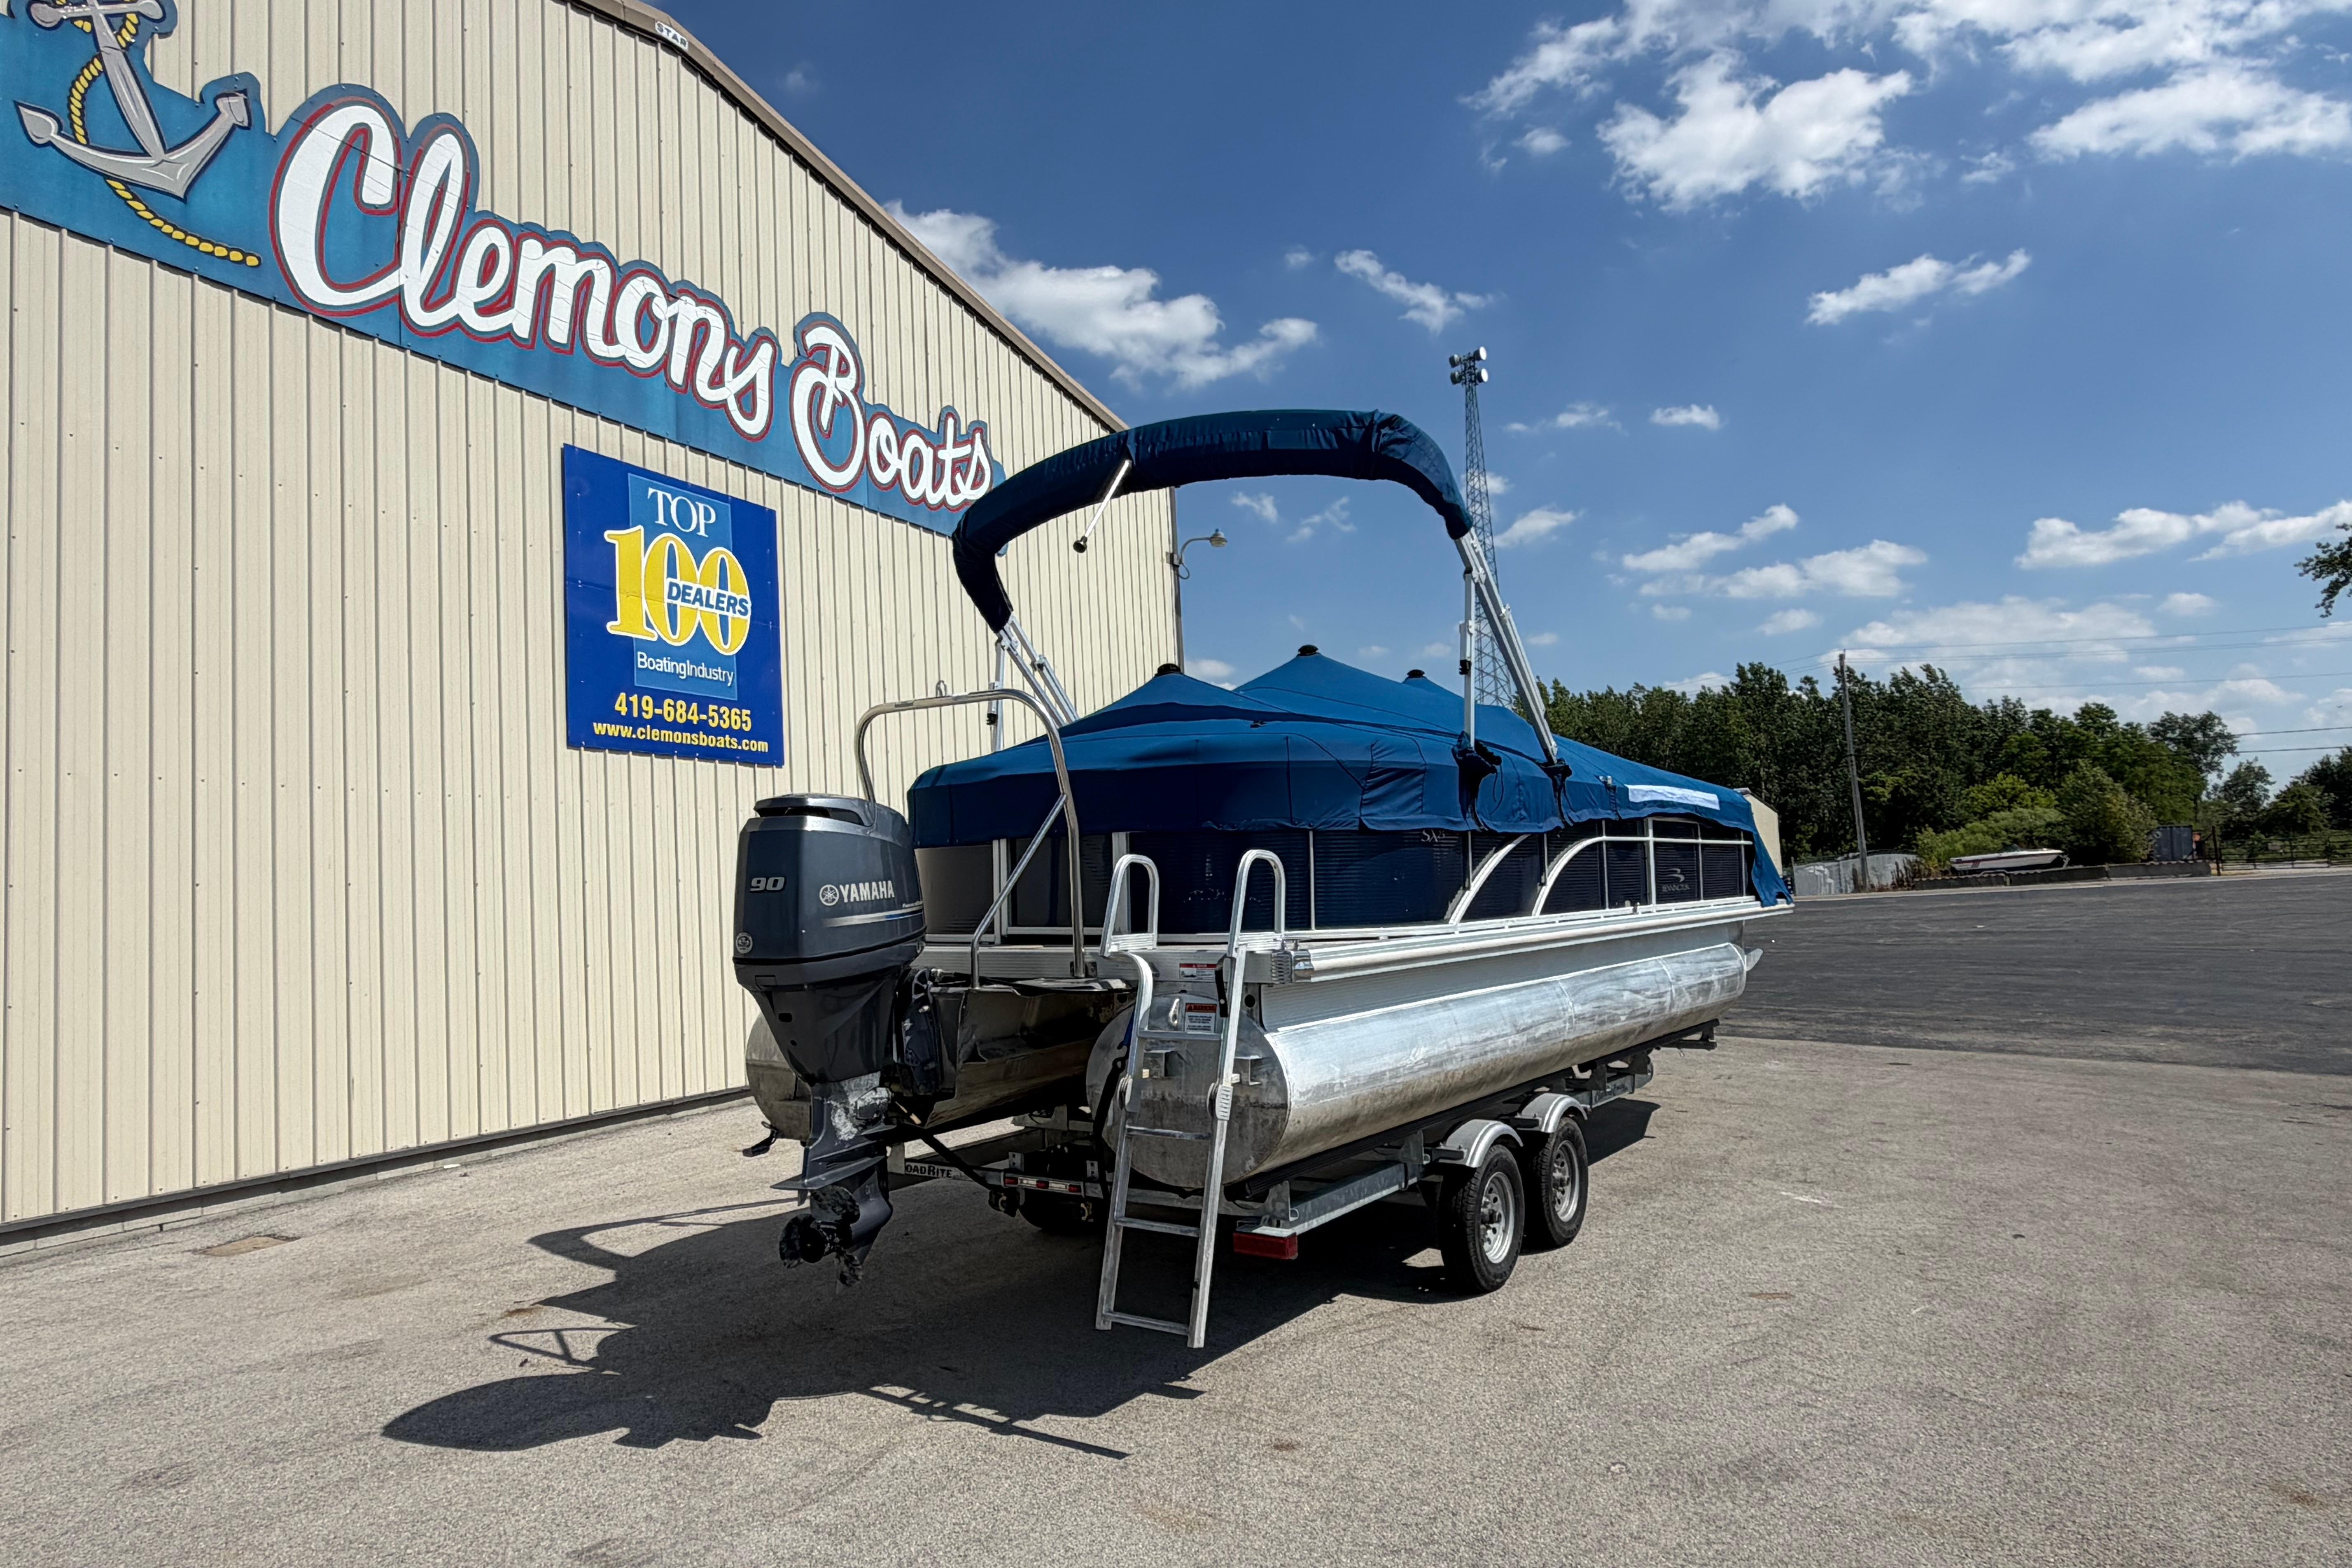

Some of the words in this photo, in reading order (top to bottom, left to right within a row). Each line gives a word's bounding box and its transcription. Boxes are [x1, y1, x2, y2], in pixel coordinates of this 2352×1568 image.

[657, 23, 686, 47] STAR
[270, 96, 773, 441] Clemons
[790, 321, 993, 512] Boats
[648, 488, 716, 537] TOP
[604, 525, 750, 656] 100
[667, 581, 749, 617] DEALERS
[637, 652, 734, 686] BoatingIndustry
[614, 692, 752, 731] 419-684-5365
[593, 721, 769, 753] www.clemonsboats.com
[749, 877, 785, 892] 90
[839, 880, 895, 903] YAMAHA
[905, 1164, 952, 1178] OADRITE
